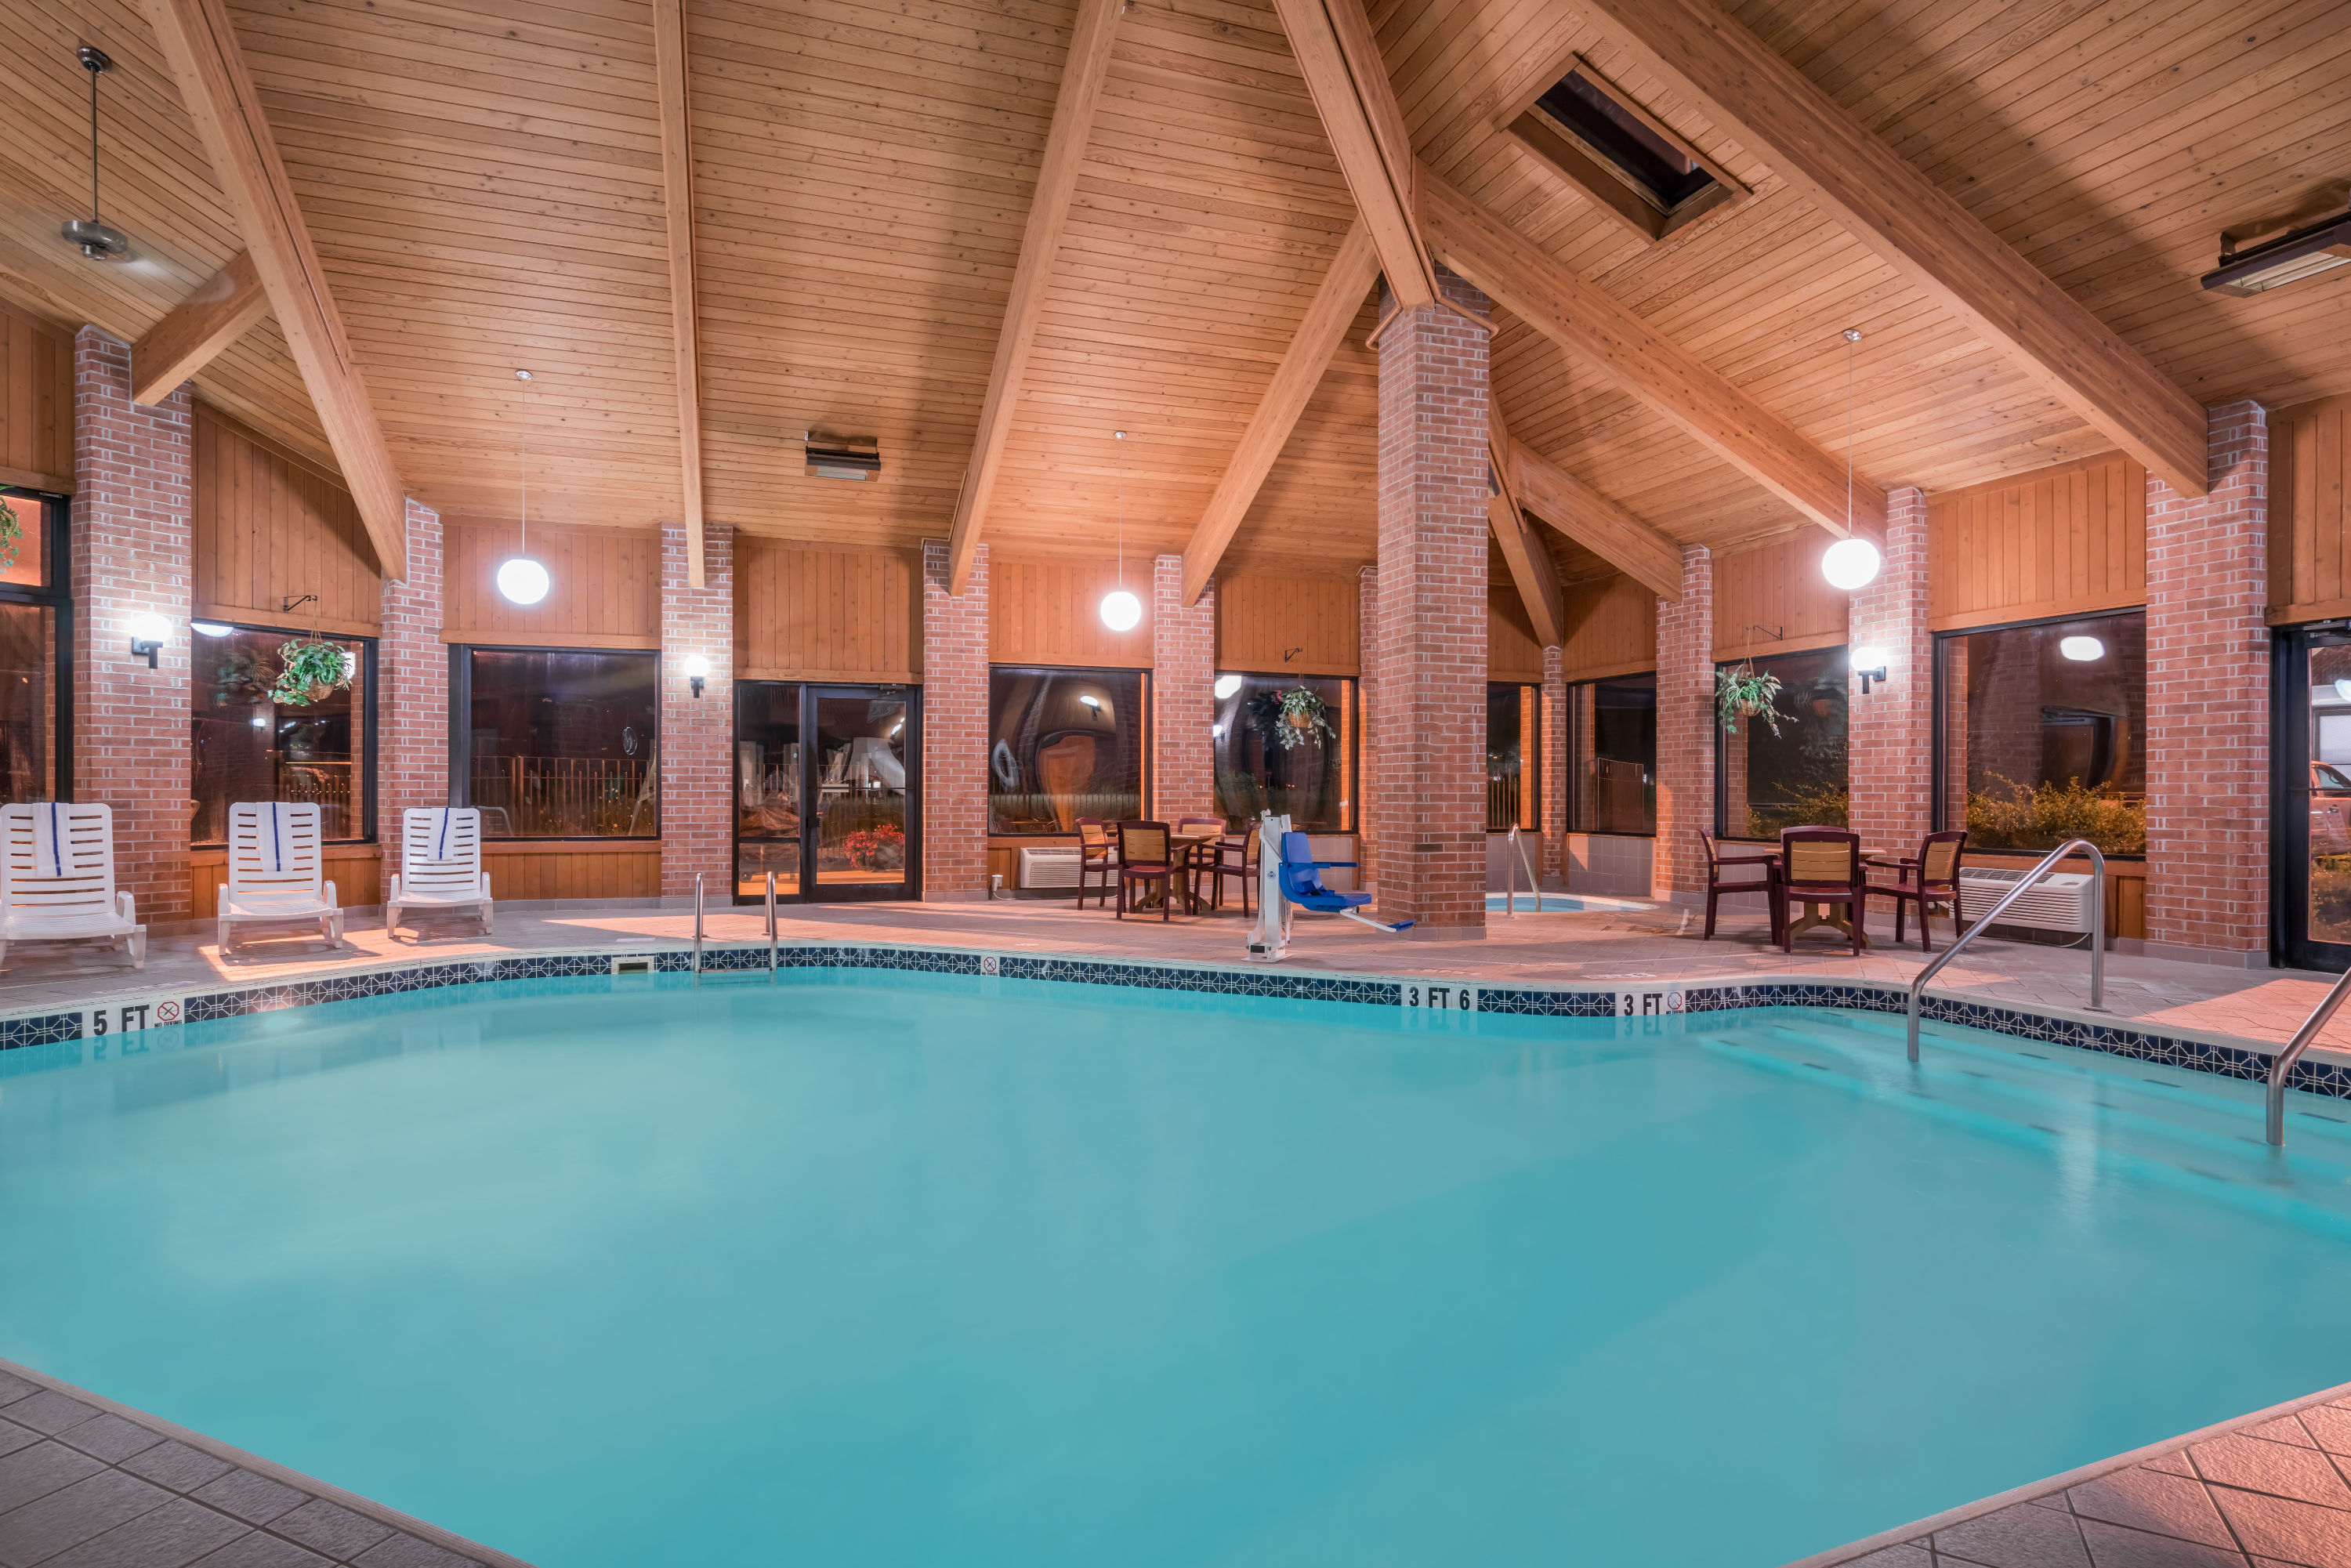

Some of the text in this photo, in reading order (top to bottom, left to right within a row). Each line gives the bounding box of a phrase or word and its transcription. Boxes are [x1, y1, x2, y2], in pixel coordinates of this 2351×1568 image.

[1409, 987, 1470, 1011] 3 FT 6
[1624, 993, 1663, 1016] 3 FT
[93, 1005, 150, 1036] 5 FT
